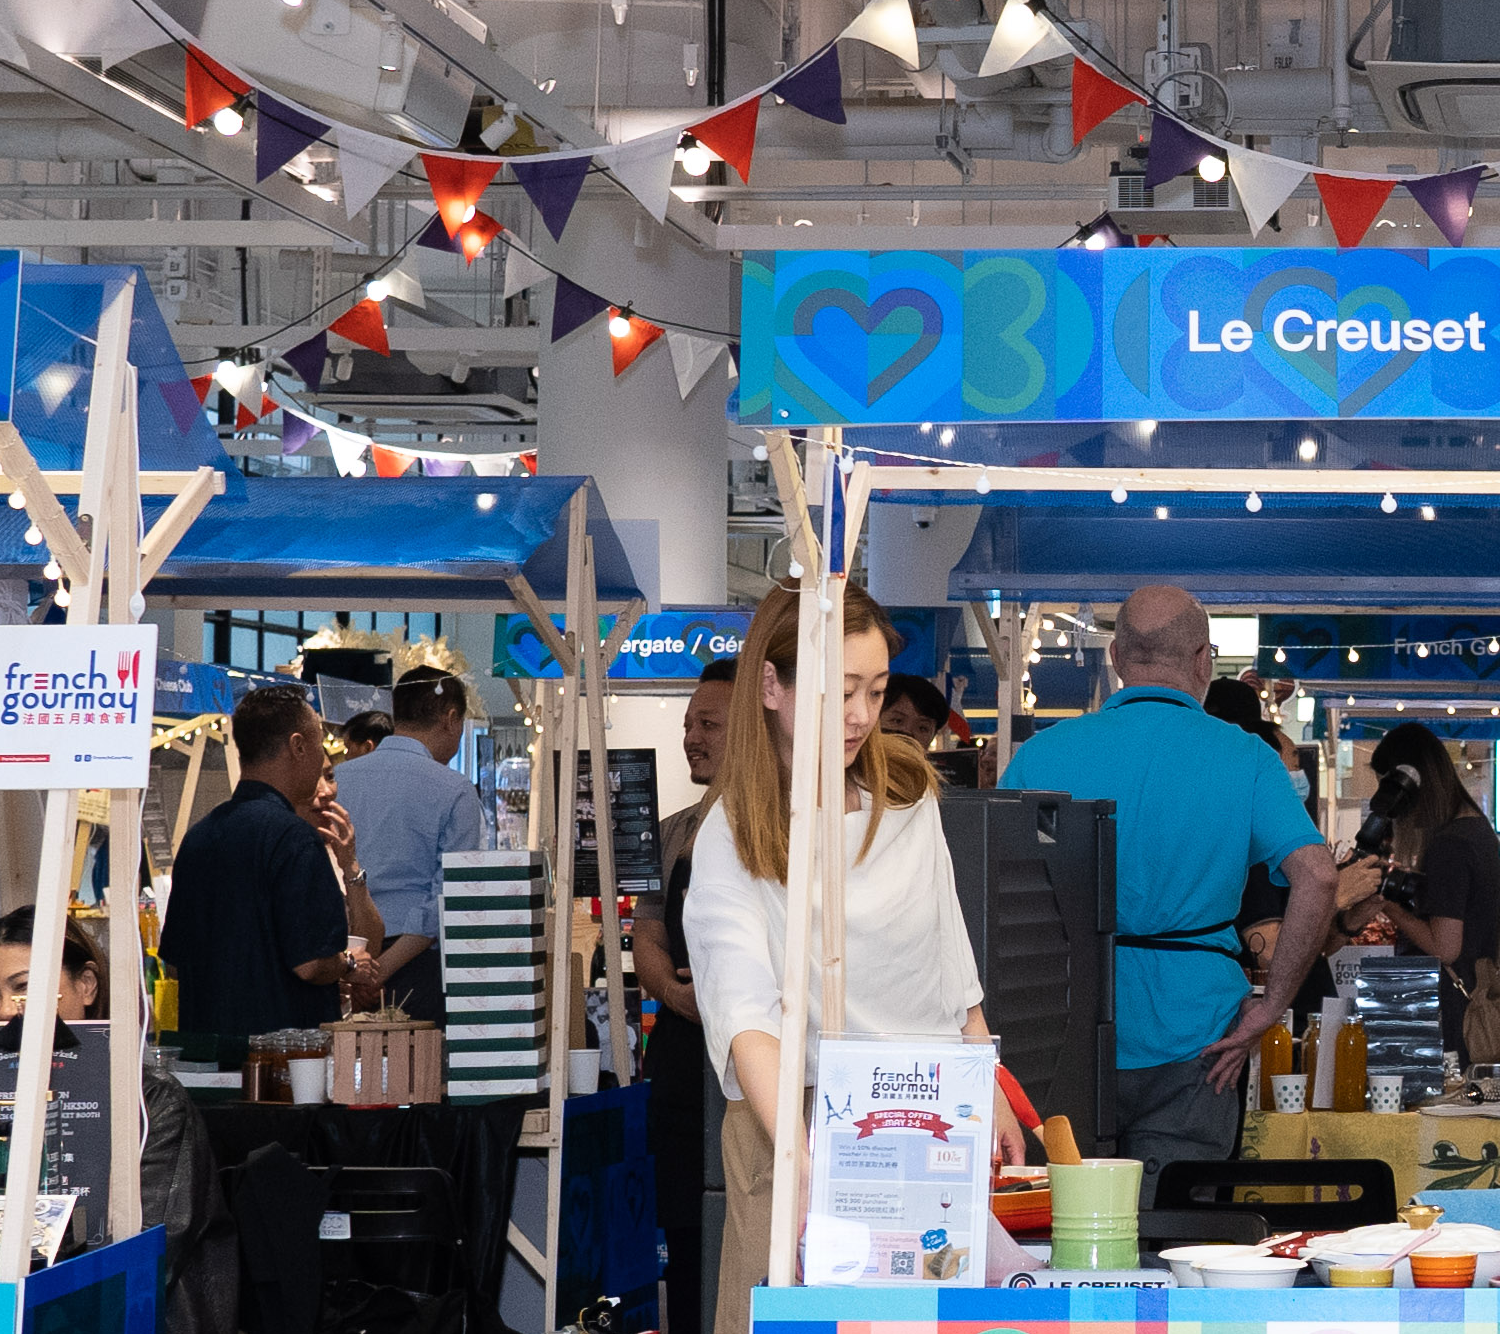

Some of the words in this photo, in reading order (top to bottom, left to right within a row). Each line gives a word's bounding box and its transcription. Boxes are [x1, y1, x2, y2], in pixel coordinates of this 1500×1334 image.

[1188, 310, 1254, 355] Le
[1273, 308, 1486, 355] Creuset
[4, 649, 108, 690] french
[0, 691, 138, 726] gourmay
[22, 712, 127, 726] 法國五月美食薈
[872, 1061, 924, 1082] french
[870, 1081, 940, 1101] gourmay
[873, 1110, 908, 1121] SPECIAL
[907, 1110, 934, 1121] OFFER
